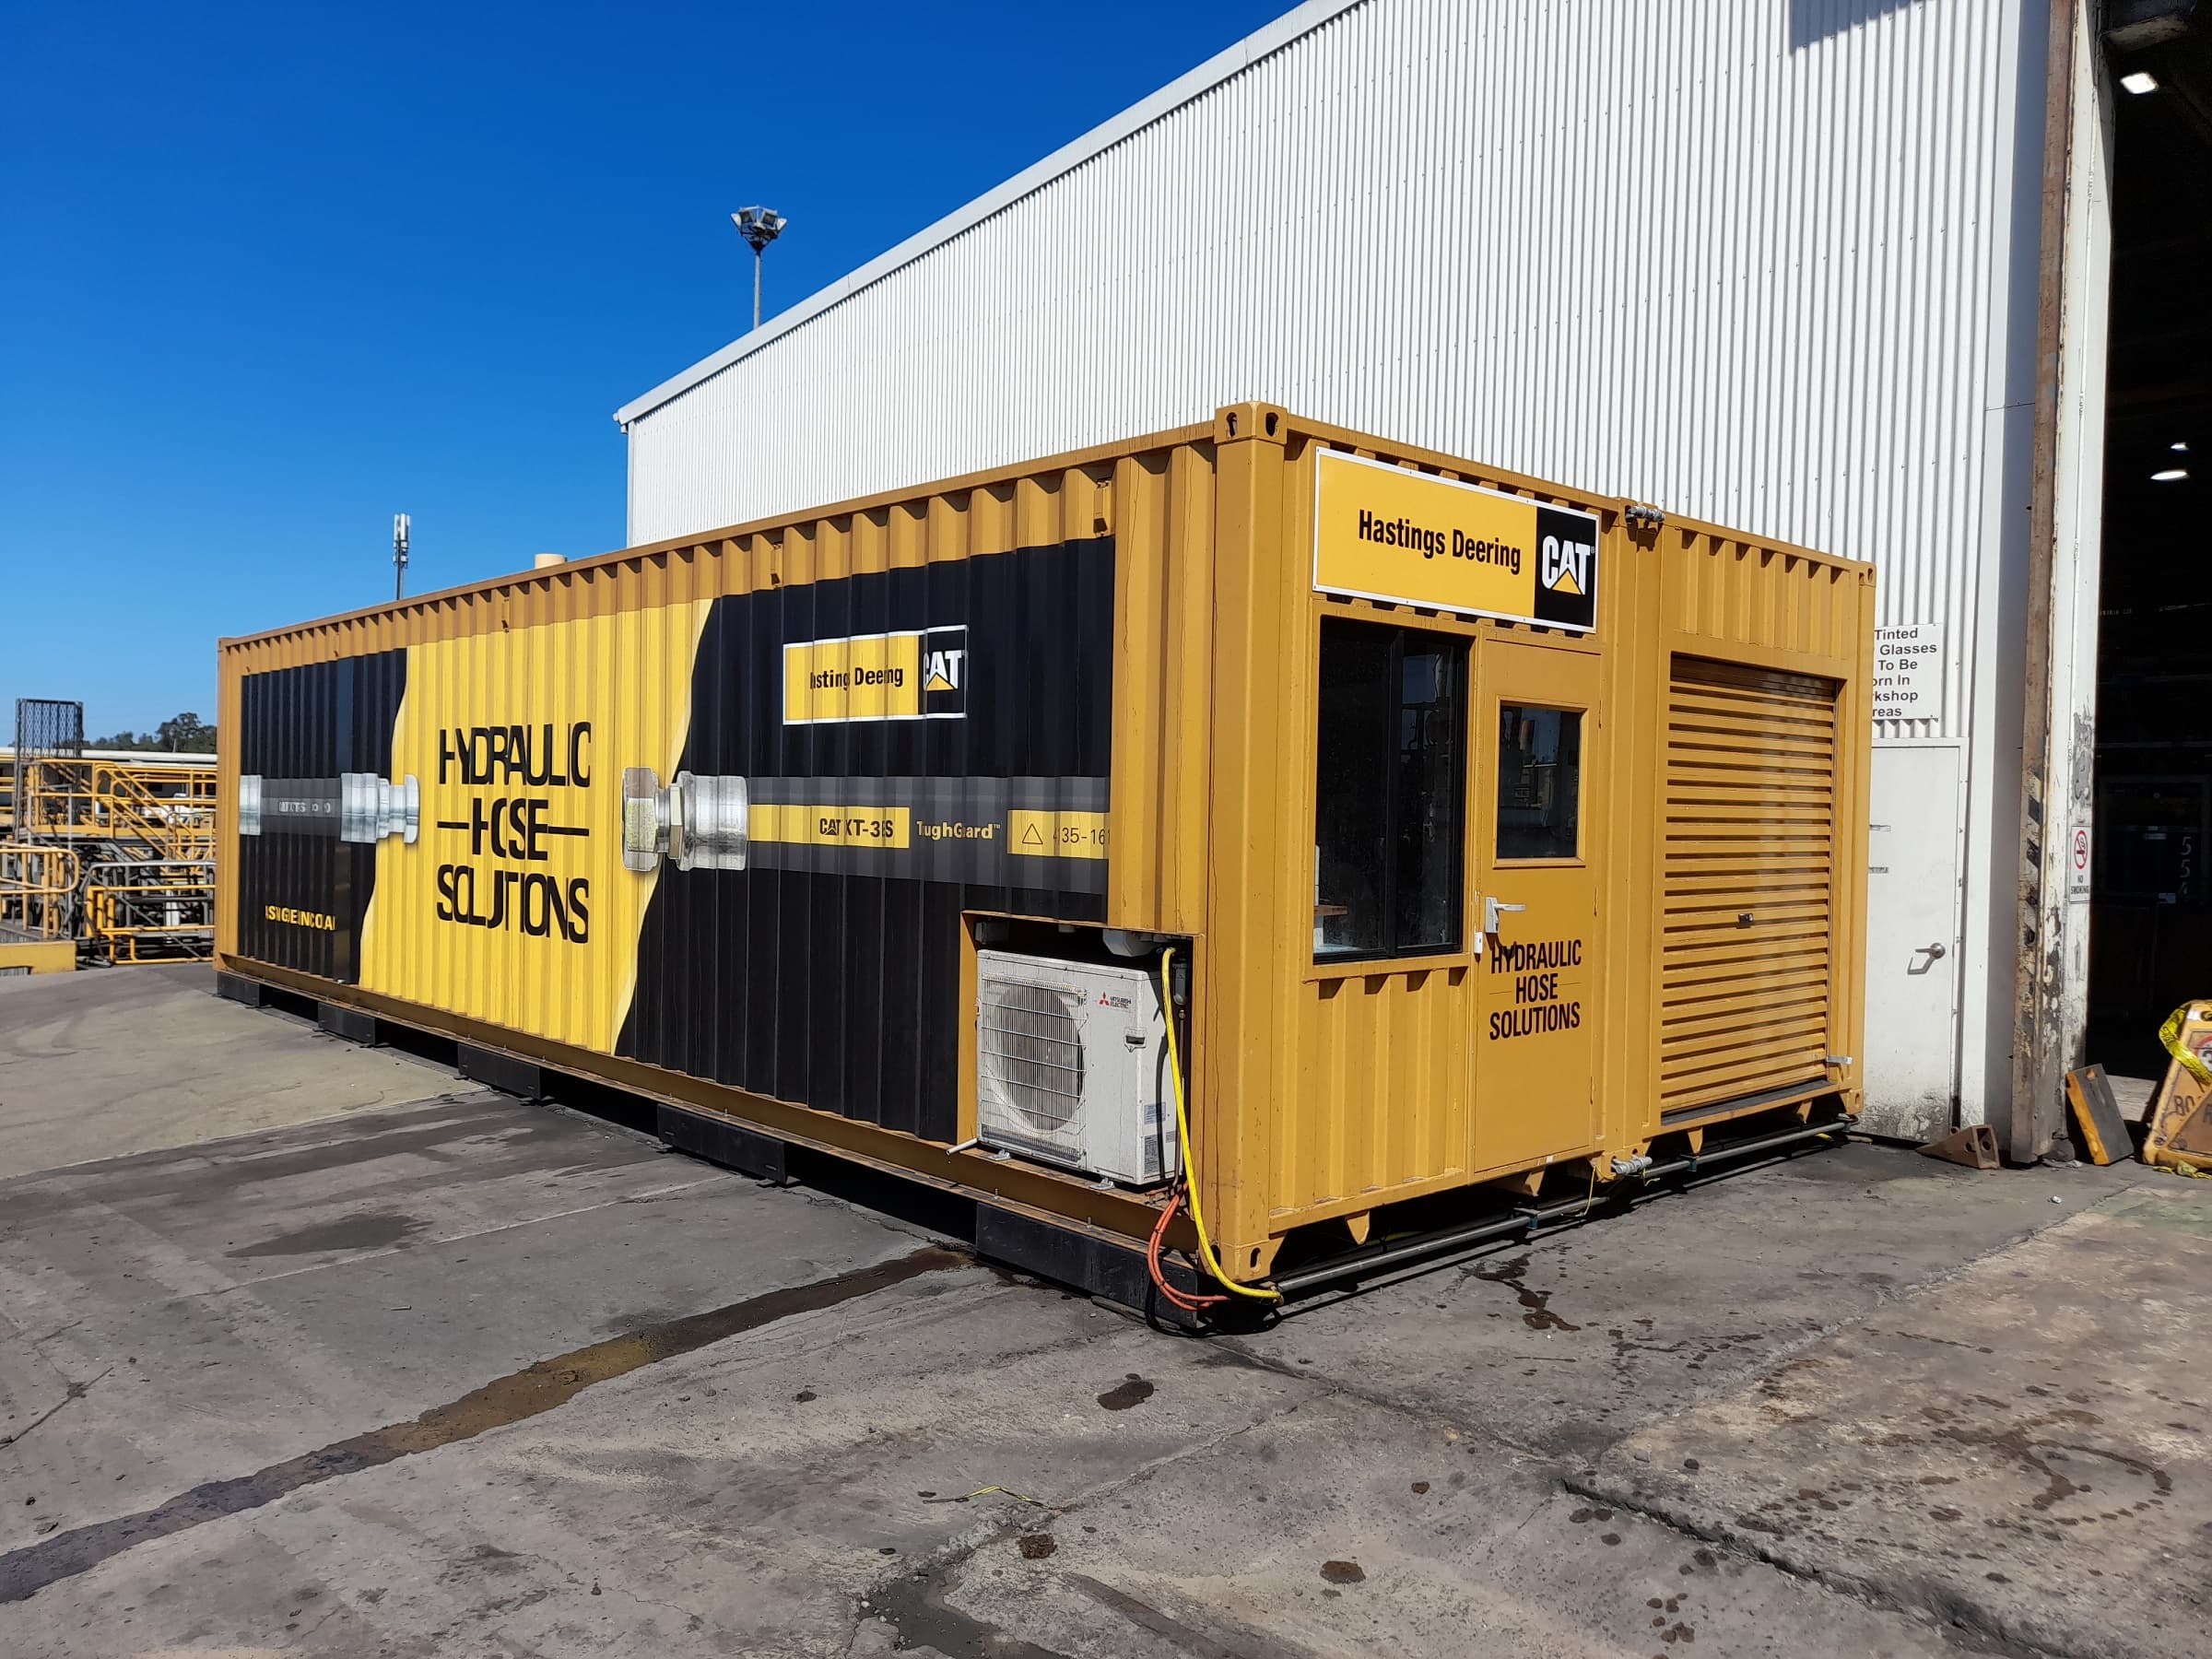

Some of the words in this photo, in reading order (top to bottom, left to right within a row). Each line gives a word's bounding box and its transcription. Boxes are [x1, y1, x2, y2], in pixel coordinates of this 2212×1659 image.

[1359, 510, 1445, 559] Hastings
[1453, 529, 1522, 575] Deering
[1542, 535, 1591, 594] CAT
[1874, 628, 1918, 641] Tinted
[1880, 644, 1937, 655] Glasses
[1873, 677, 1892, 686] orn
[1898, 675, 1910, 686] In
[1878, 660, 1894, 670] To
[1900, 659, 1918, 670] Be
[1873, 708, 1902, 716] reas
[440, 722, 592, 787] HYDRAULIC
[472, 798, 548, 861] HOSE
[437, 865, 589, 944] SOLUTIONS
[1490, 939, 1582, 973] HYDRAULIC
[1515, 973, 1559, 1004] HOSE
[1489, 1002, 1580, 1040] SOLUTIONS
